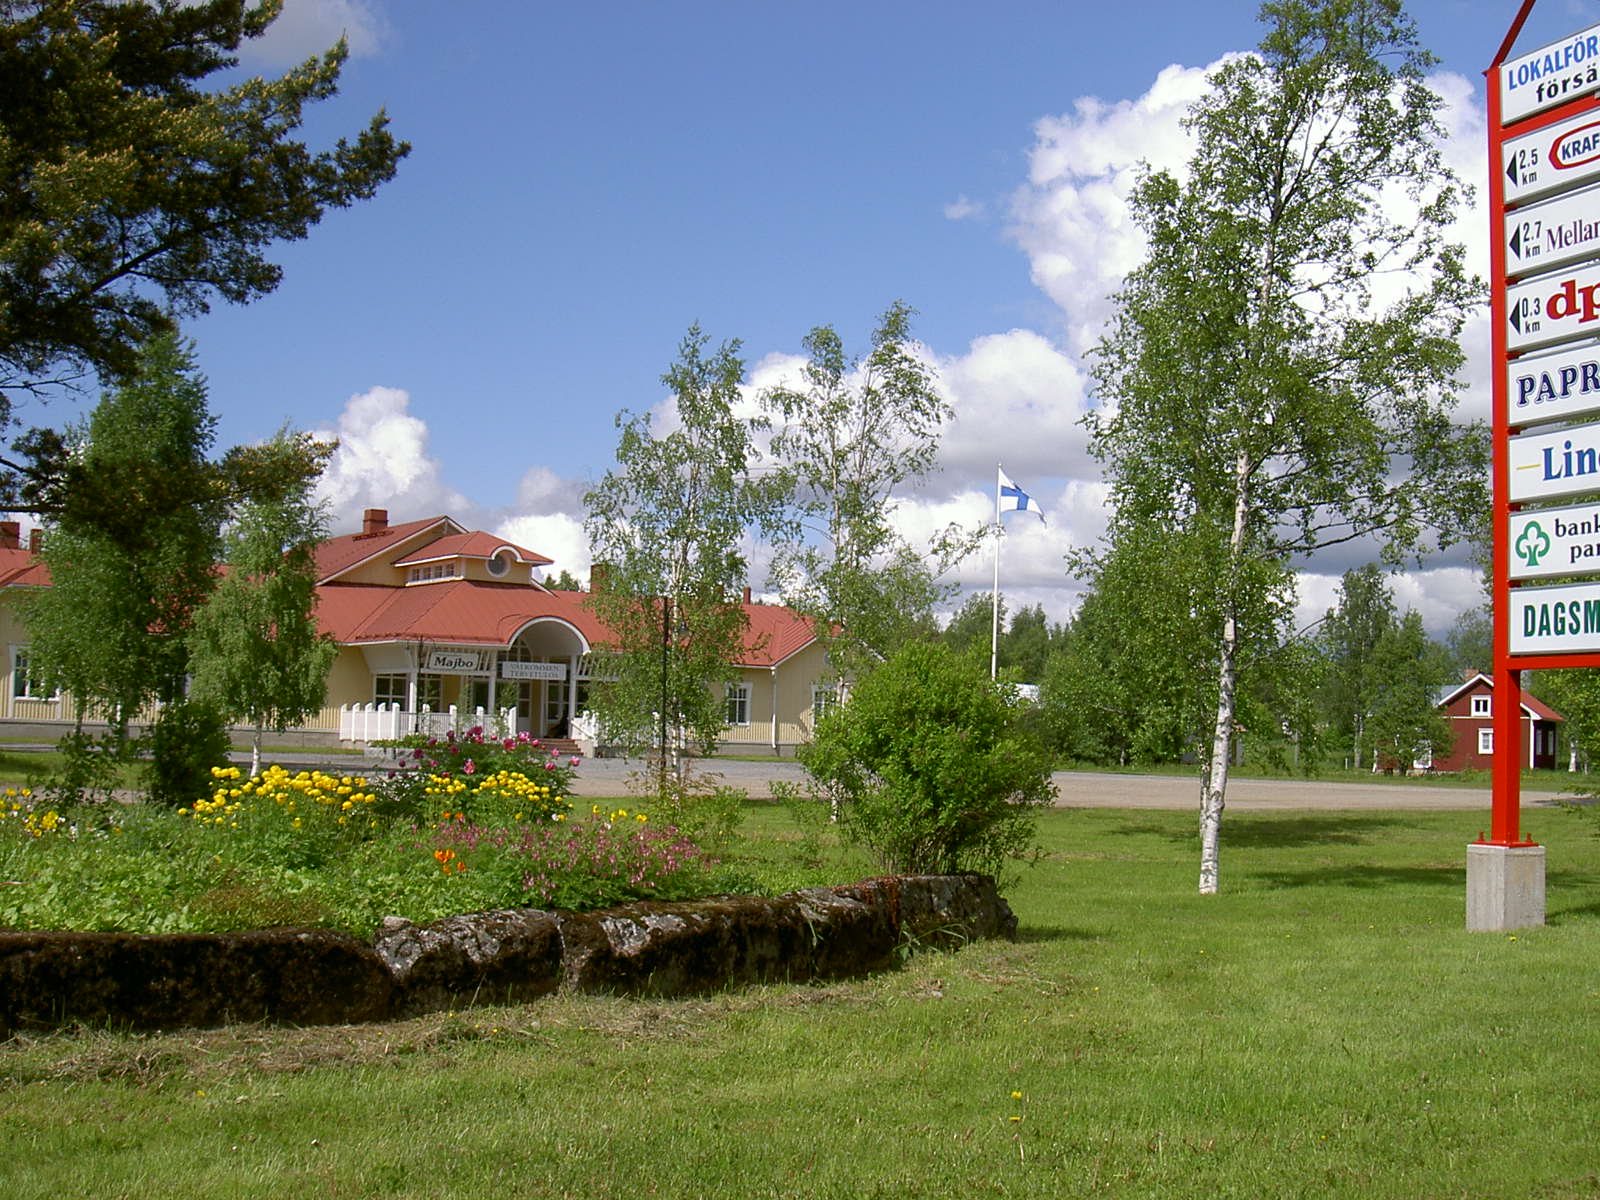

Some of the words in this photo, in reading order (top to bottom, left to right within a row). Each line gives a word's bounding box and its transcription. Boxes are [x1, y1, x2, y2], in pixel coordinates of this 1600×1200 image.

[1507, 36, 1599, 91] LOKALFÖR
[1536, 63, 1598, 103] försä
[1519, 148, 1538, 169] 2.5
[1521, 171, 1538, 185] km
[1523, 220, 1542, 242] 2.7
[1525, 245, 1541, 259] km
[1522, 297, 1541, 318] 0.3
[1525, 320, 1541, 334] km
[1517, 361, 1600, 407] PAPR
[1542, 440, 1600, 480] Lin
[1523, 600, 1600, 637] DAGSM
[434, 656, 473, 670] Majbo
